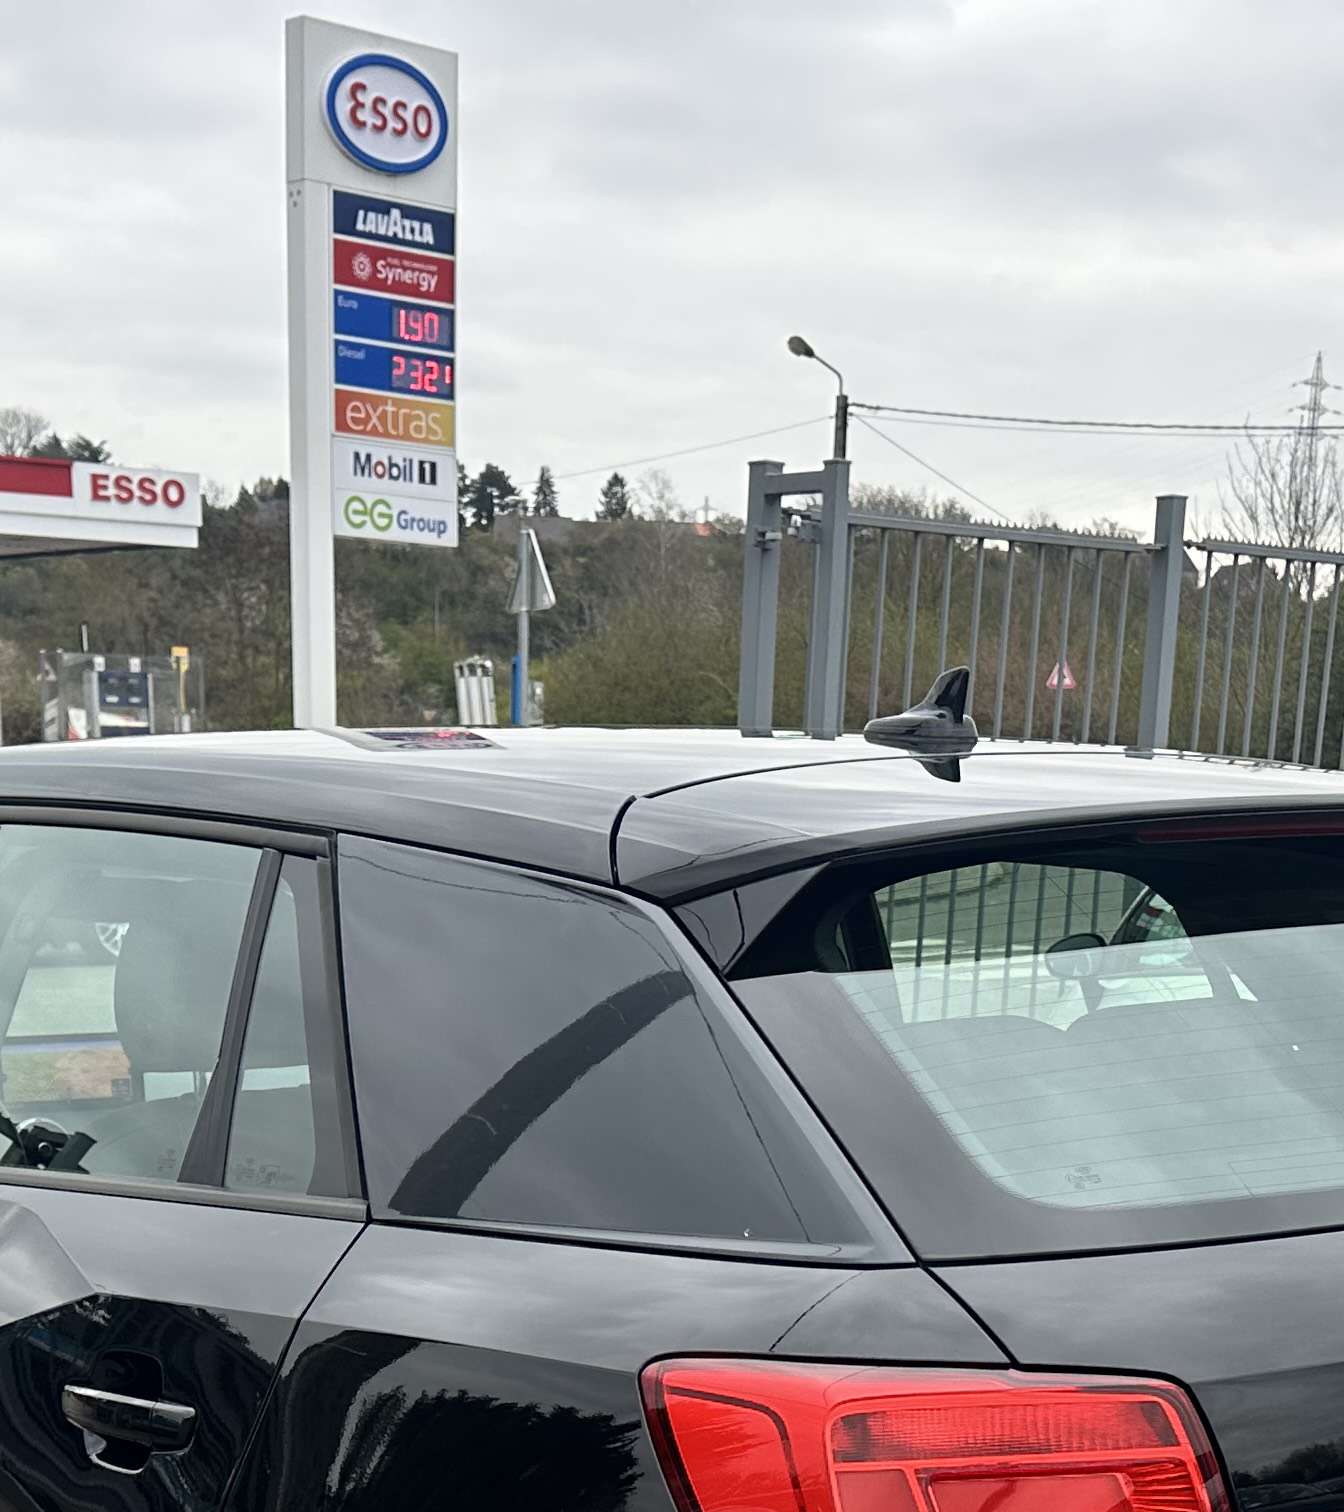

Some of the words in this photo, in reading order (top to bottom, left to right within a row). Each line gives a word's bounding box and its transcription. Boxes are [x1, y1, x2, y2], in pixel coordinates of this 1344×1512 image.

[355, 207, 434, 245] LAVAZZA
[376, 259, 438, 292] Synergy
[345, 399, 443, 440] extras
[353, 451, 413, 483] Mobil
[90, 473, 185, 508] ESSO
[396, 510, 447, 539] Group
